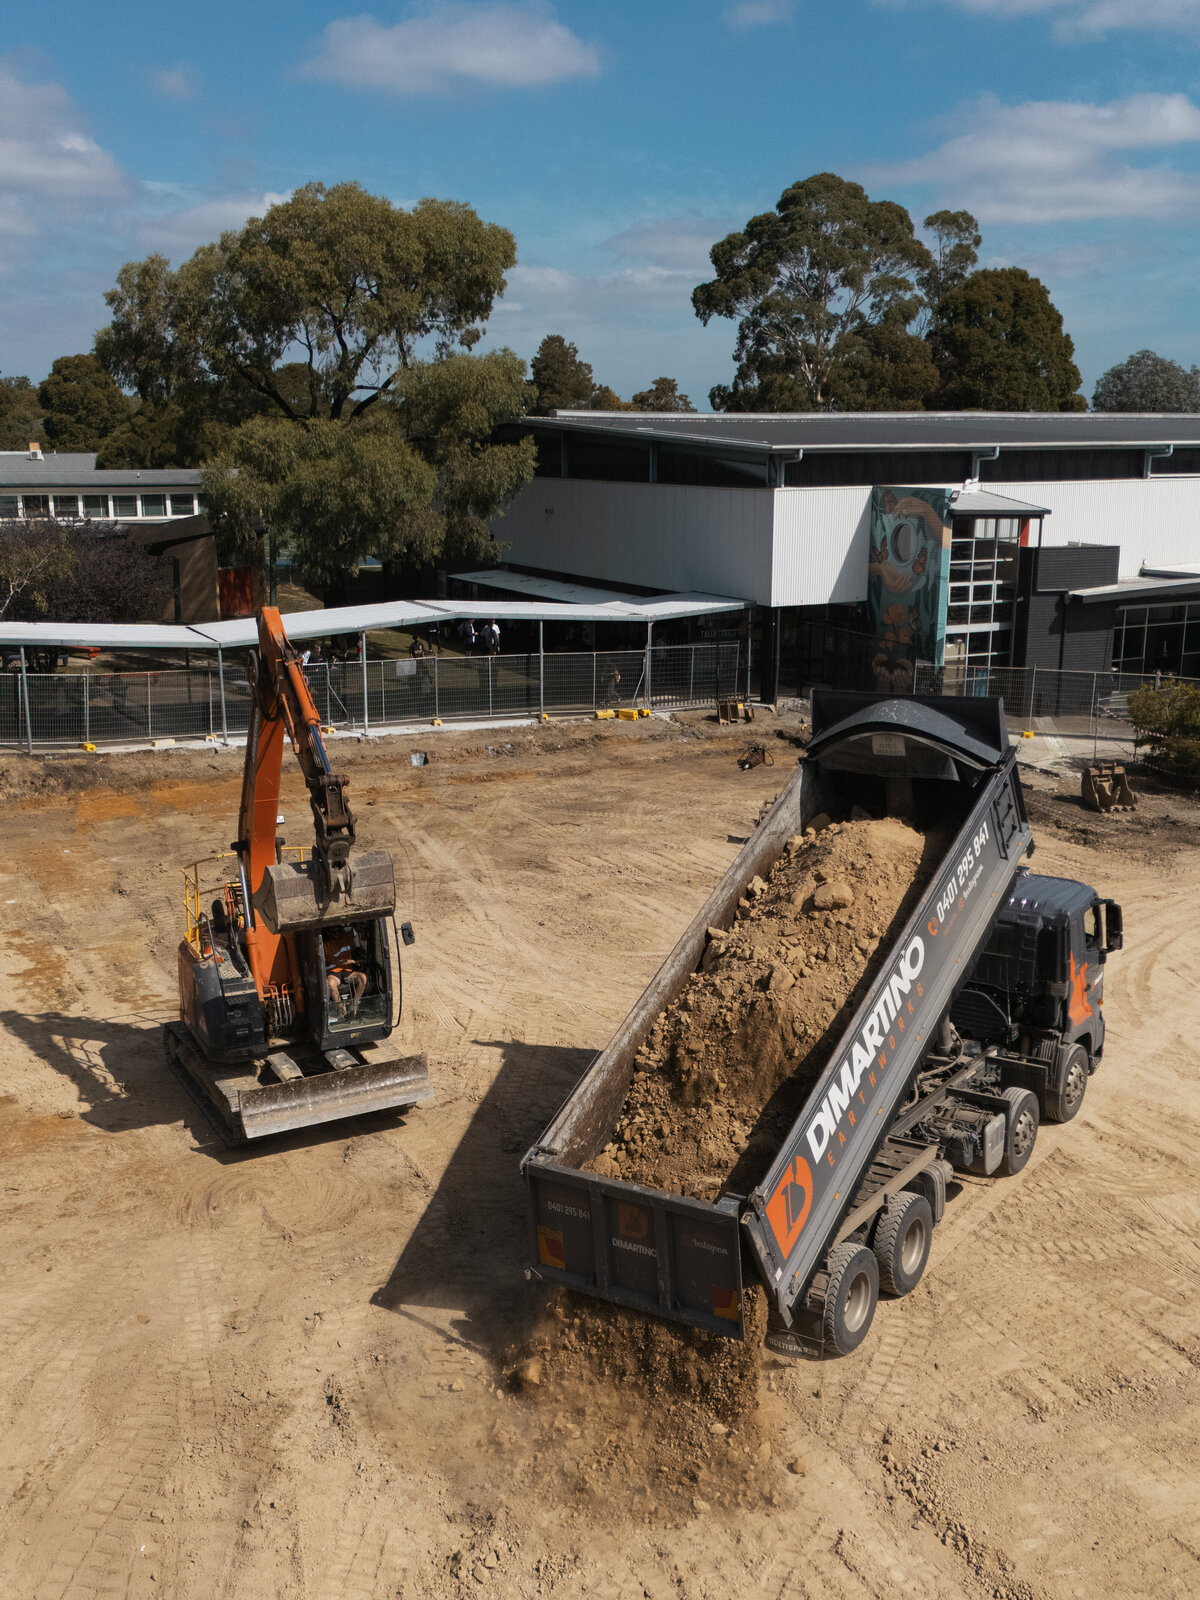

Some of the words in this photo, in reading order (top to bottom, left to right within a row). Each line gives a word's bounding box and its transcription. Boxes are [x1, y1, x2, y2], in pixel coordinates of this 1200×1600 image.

[937, 876, 958, 923] 0401
[957, 847, 974, 887] 295
[973, 821, 990, 857] 841
[806, 936, 925, 1164] DIMARTINO
[547, 1200, 564, 1213] 0401
[564, 1206, 578, 1217] 295
[578, 1209, 591, 1220] 841
[611, 1237, 658, 1258] DIMARTINO
